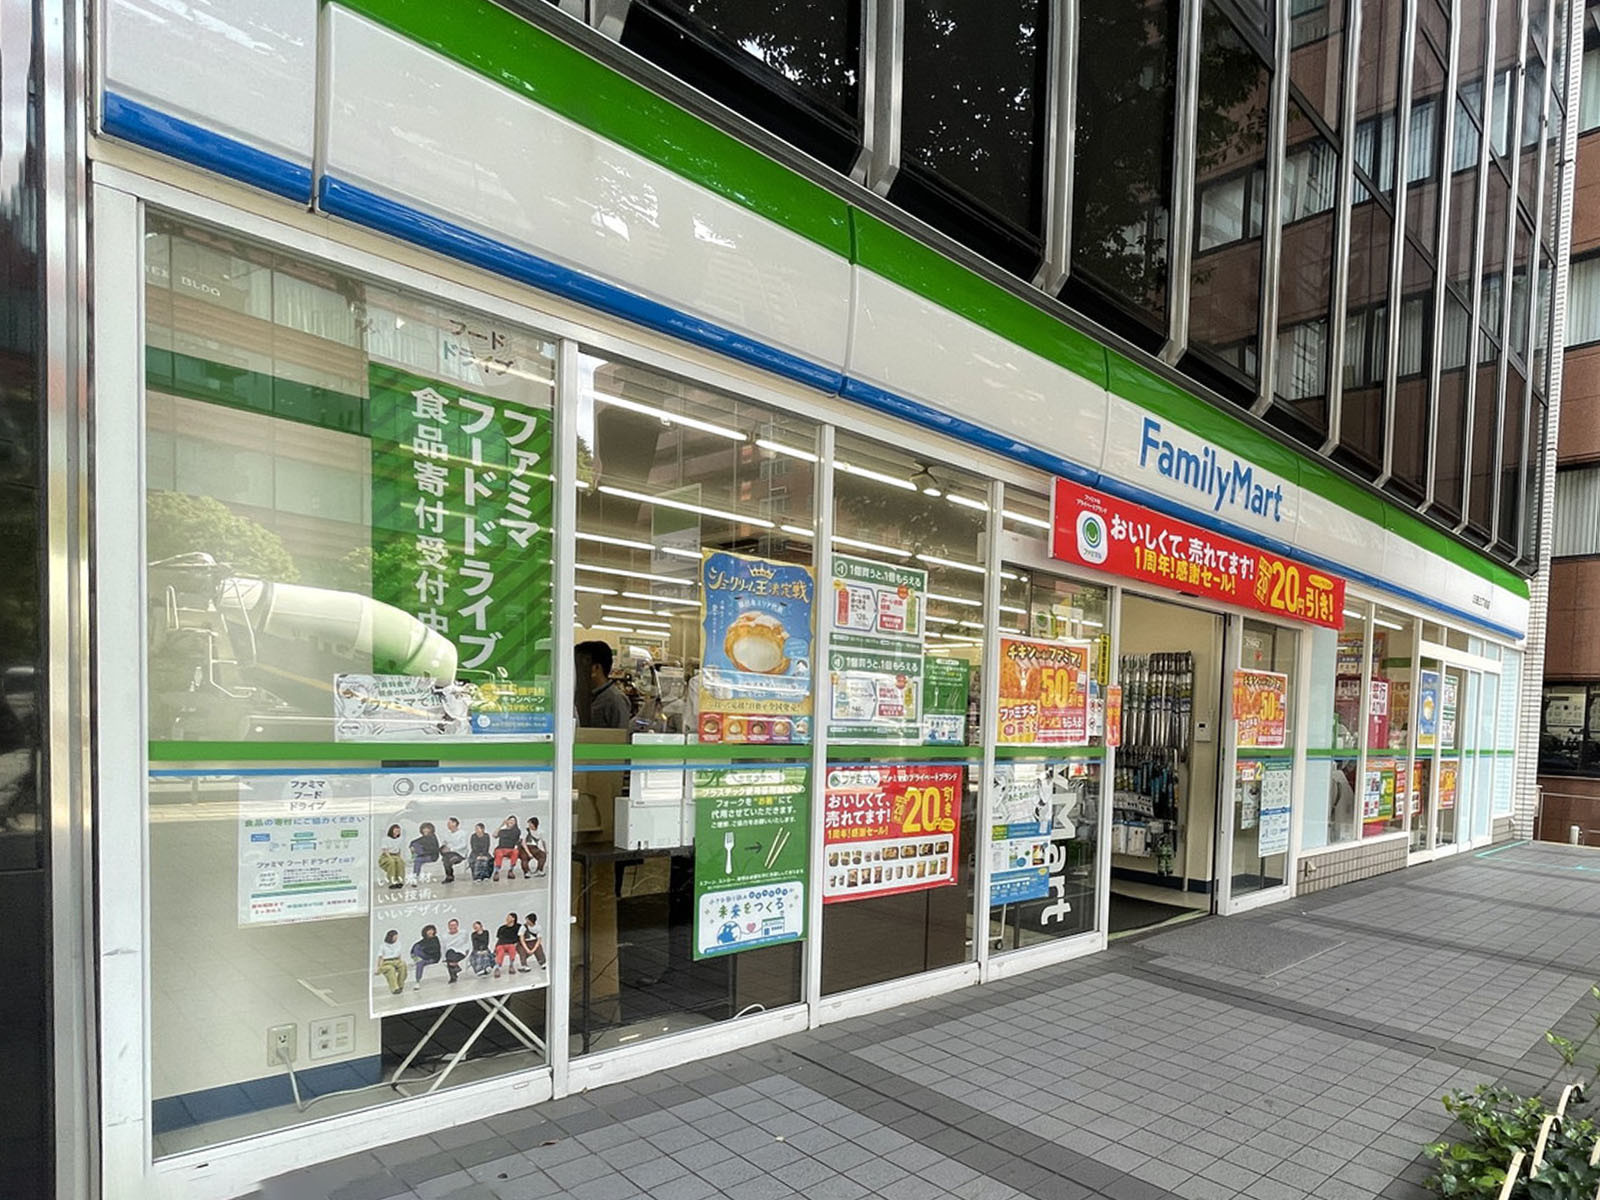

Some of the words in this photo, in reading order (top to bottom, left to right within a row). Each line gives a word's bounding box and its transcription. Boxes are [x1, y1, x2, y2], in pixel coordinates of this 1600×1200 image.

[410, 386, 450, 635] 食品寄付受付中
[499, 408, 541, 549] ファミマ
[1139, 416, 1283, 522] FamilyMart
[458, 397, 503, 669] フードドライブ
[294, 790, 322, 800] フード
[418, 780, 502, 793] Convenience
[505, 780, 536, 791] Wear
